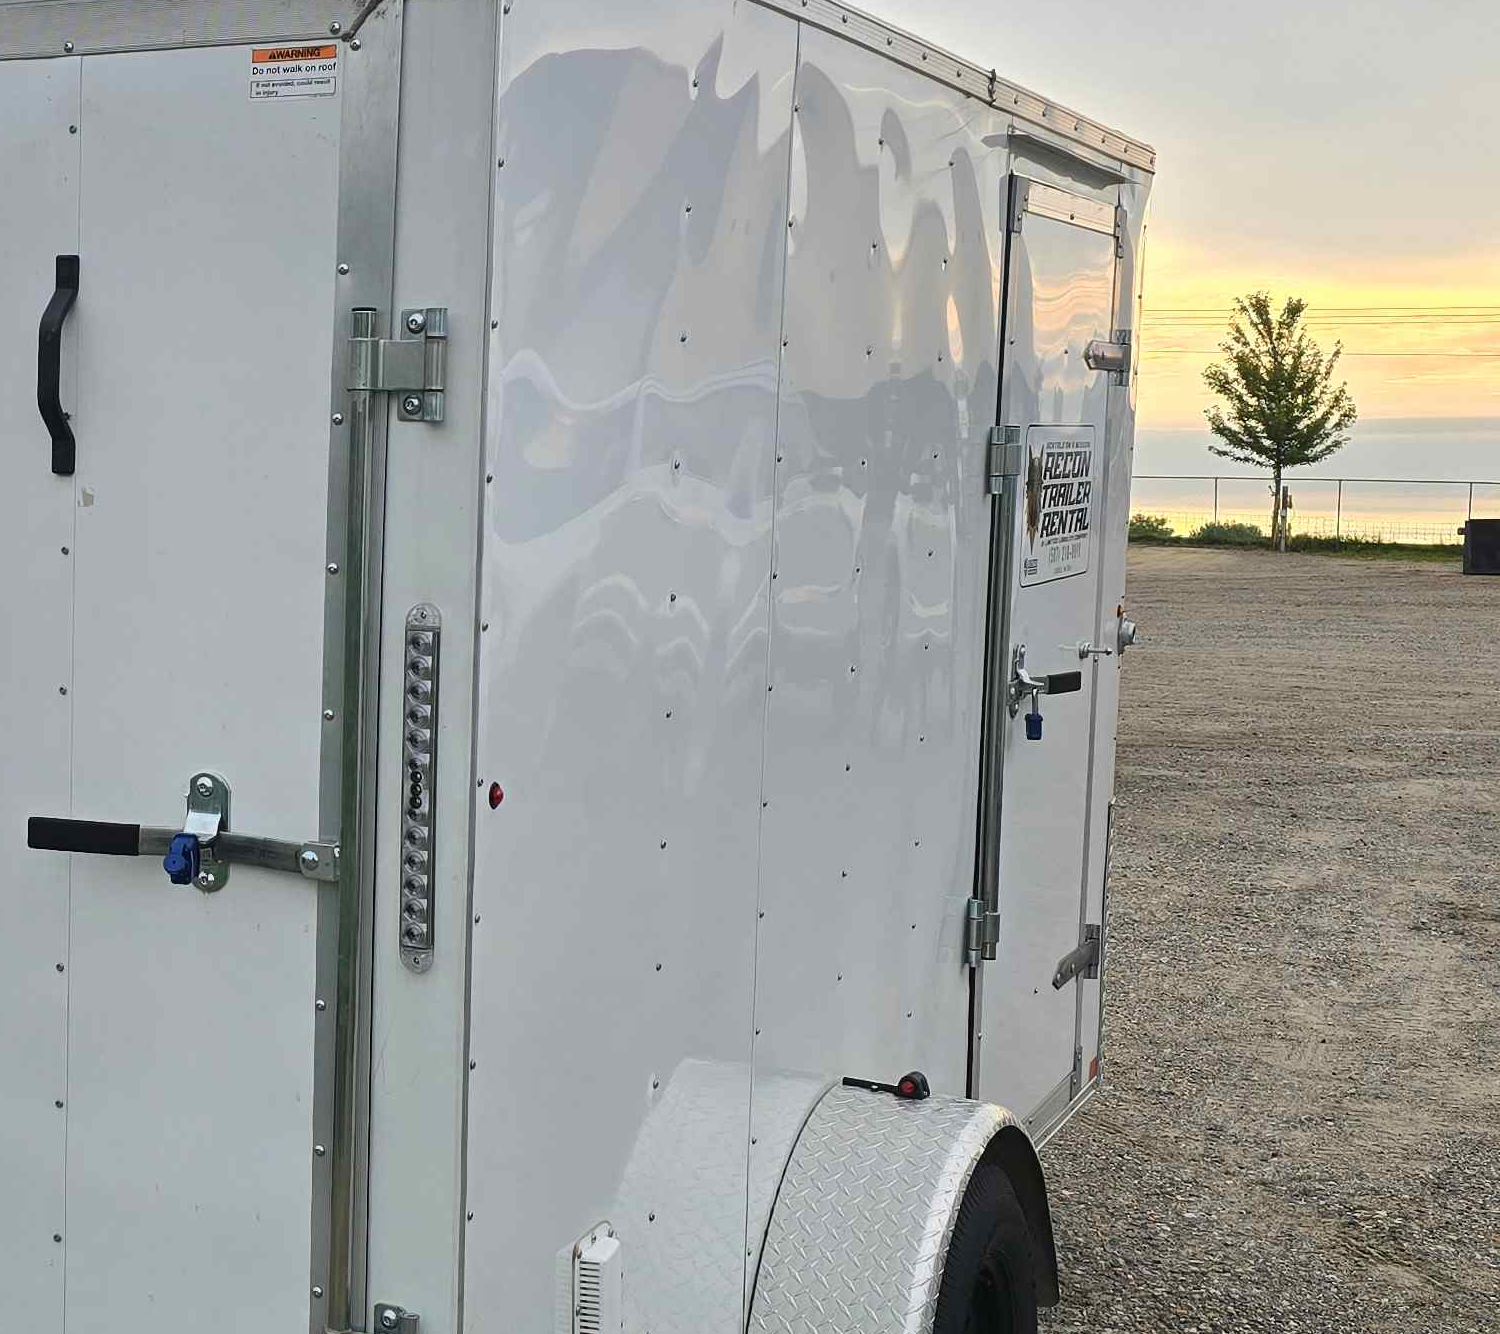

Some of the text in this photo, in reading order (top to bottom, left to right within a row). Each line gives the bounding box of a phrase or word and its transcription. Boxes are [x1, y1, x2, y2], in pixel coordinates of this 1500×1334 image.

[252, 62, 337, 75] Do not walk on roof
[276, 48, 321, 60] WARNING
[1043, 450, 1092, 480] RECON
[1041, 481, 1092, 510] TRAILER
[1039, 507, 1089, 538] RENTAL
